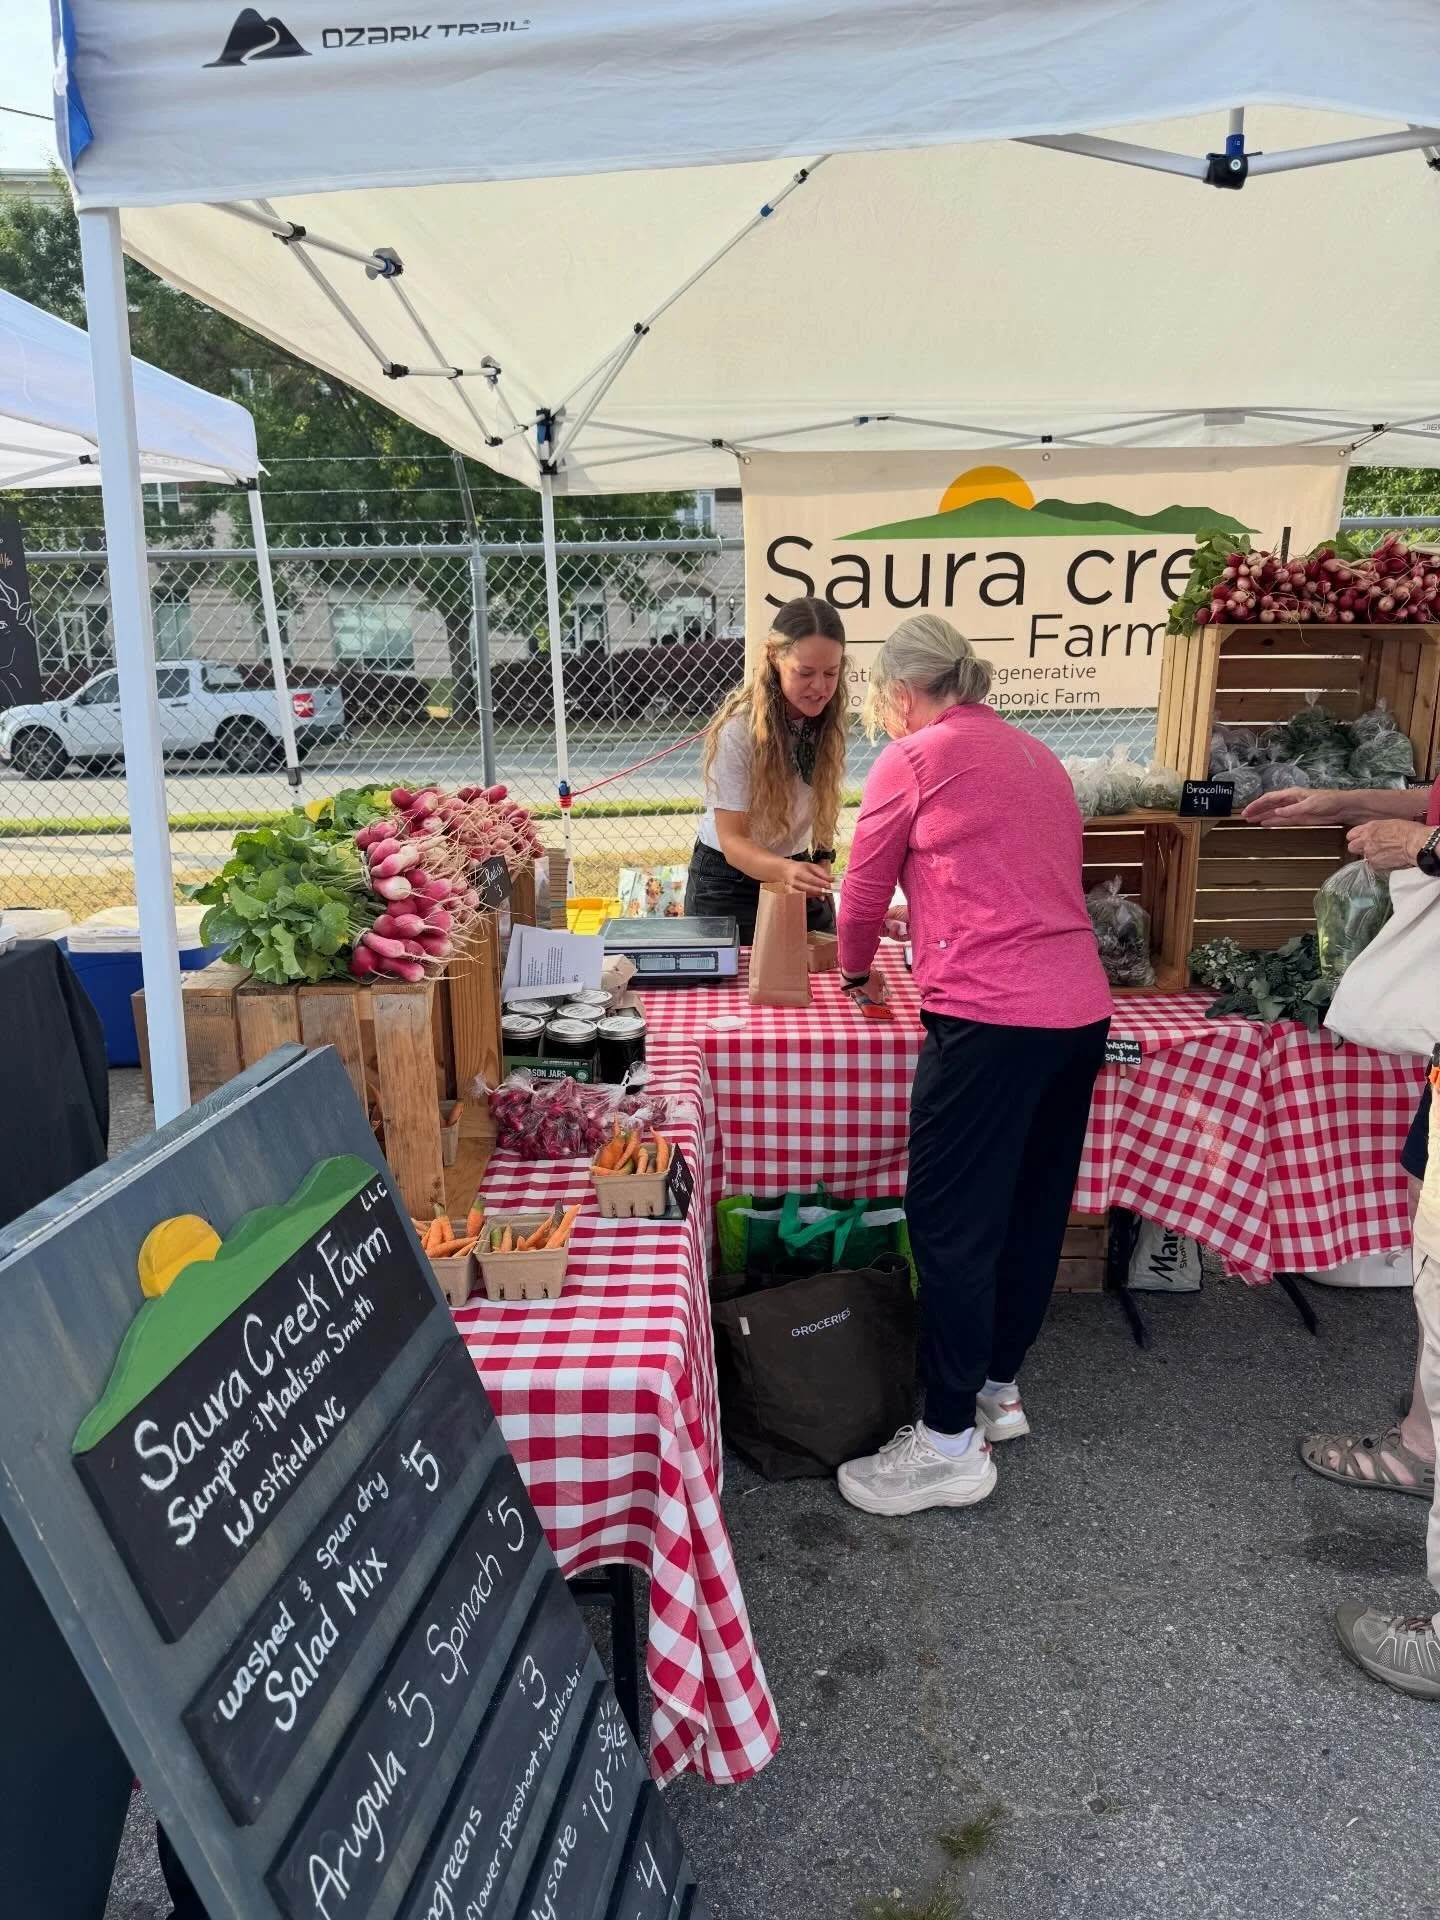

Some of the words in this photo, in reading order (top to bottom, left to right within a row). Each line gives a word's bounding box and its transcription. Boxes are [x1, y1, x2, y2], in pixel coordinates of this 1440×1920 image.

[764, 535, 1026, 609] Saura
[1029, 613, 1167, 658] Farm
[990, 663, 1097, 685] egenerative
[984, 688, 1049, 710] aponic
[1055, 688, 1101, 705] Farm
[1186, 782, 1233, 795] Brocollini
[1193, 796, 1209, 810] $4
[1105, 1041, 1140, 1051] Washed
[548, 1069, 567, 1078] JARS
[360, 1182, 388, 1212] LLC
[134, 1369, 252, 1491] Saura
[243, 1275, 330, 1377] Creek
[316, 1226, 392, 1299] Farm
[167, 1429, 251, 1547] Sumpter
[258, 1348, 330, 1433] Madison
[326, 1294, 375, 1354] Smith
[217, 1600, 296, 1721] washed
[316, 1512, 357, 1571] spun
[356, 1472, 389, 1513] dry
[399, 1439, 440, 1491] $5
[264, 1602, 340, 1732] Salad
[335, 1547, 388, 1616] Mix
[518, 1654, 547, 1711] $3
[309, 1750, 407, 1920] Arugula
[387, 1680, 435, 1748] $5
[426, 1551, 503, 1685] Spinach
[486, 1495, 525, 1552] $5
[597, 1722, 628, 1752] SALE
[632, 1840, 668, 1897] $4
